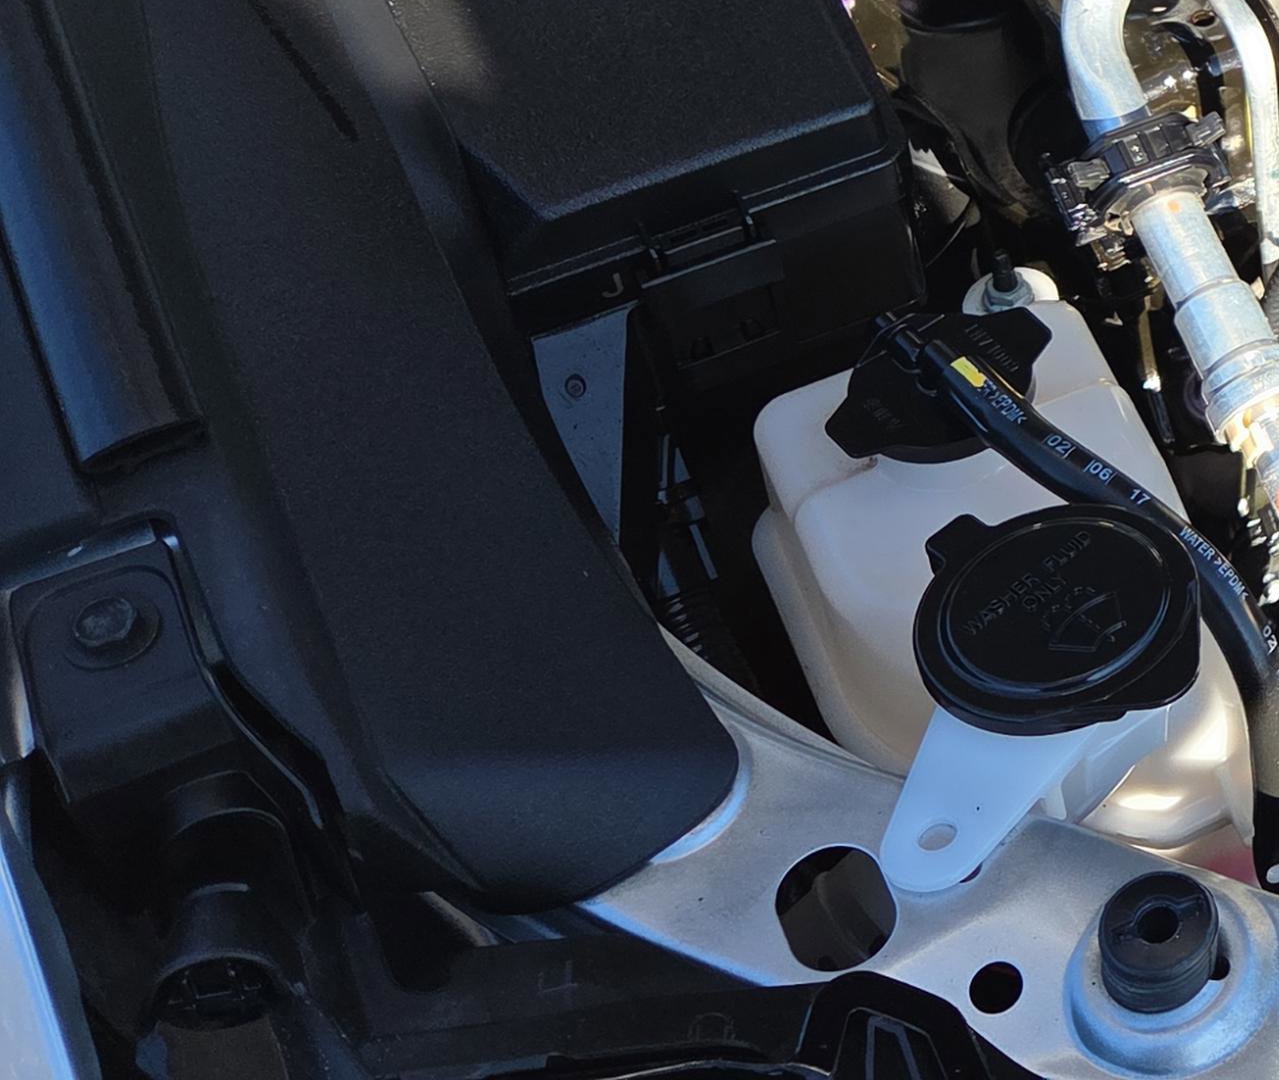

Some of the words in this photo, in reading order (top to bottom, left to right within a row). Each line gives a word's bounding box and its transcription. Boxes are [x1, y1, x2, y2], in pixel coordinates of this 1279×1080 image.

[1129, 488, 1151, 505] 17
[1179, 526, 1216, 561] WATER
[961, 572, 1041, 636] WASHER
[1042, 530, 1091, 572] FLUID
[1022, 572, 1068, 609] ONLY
